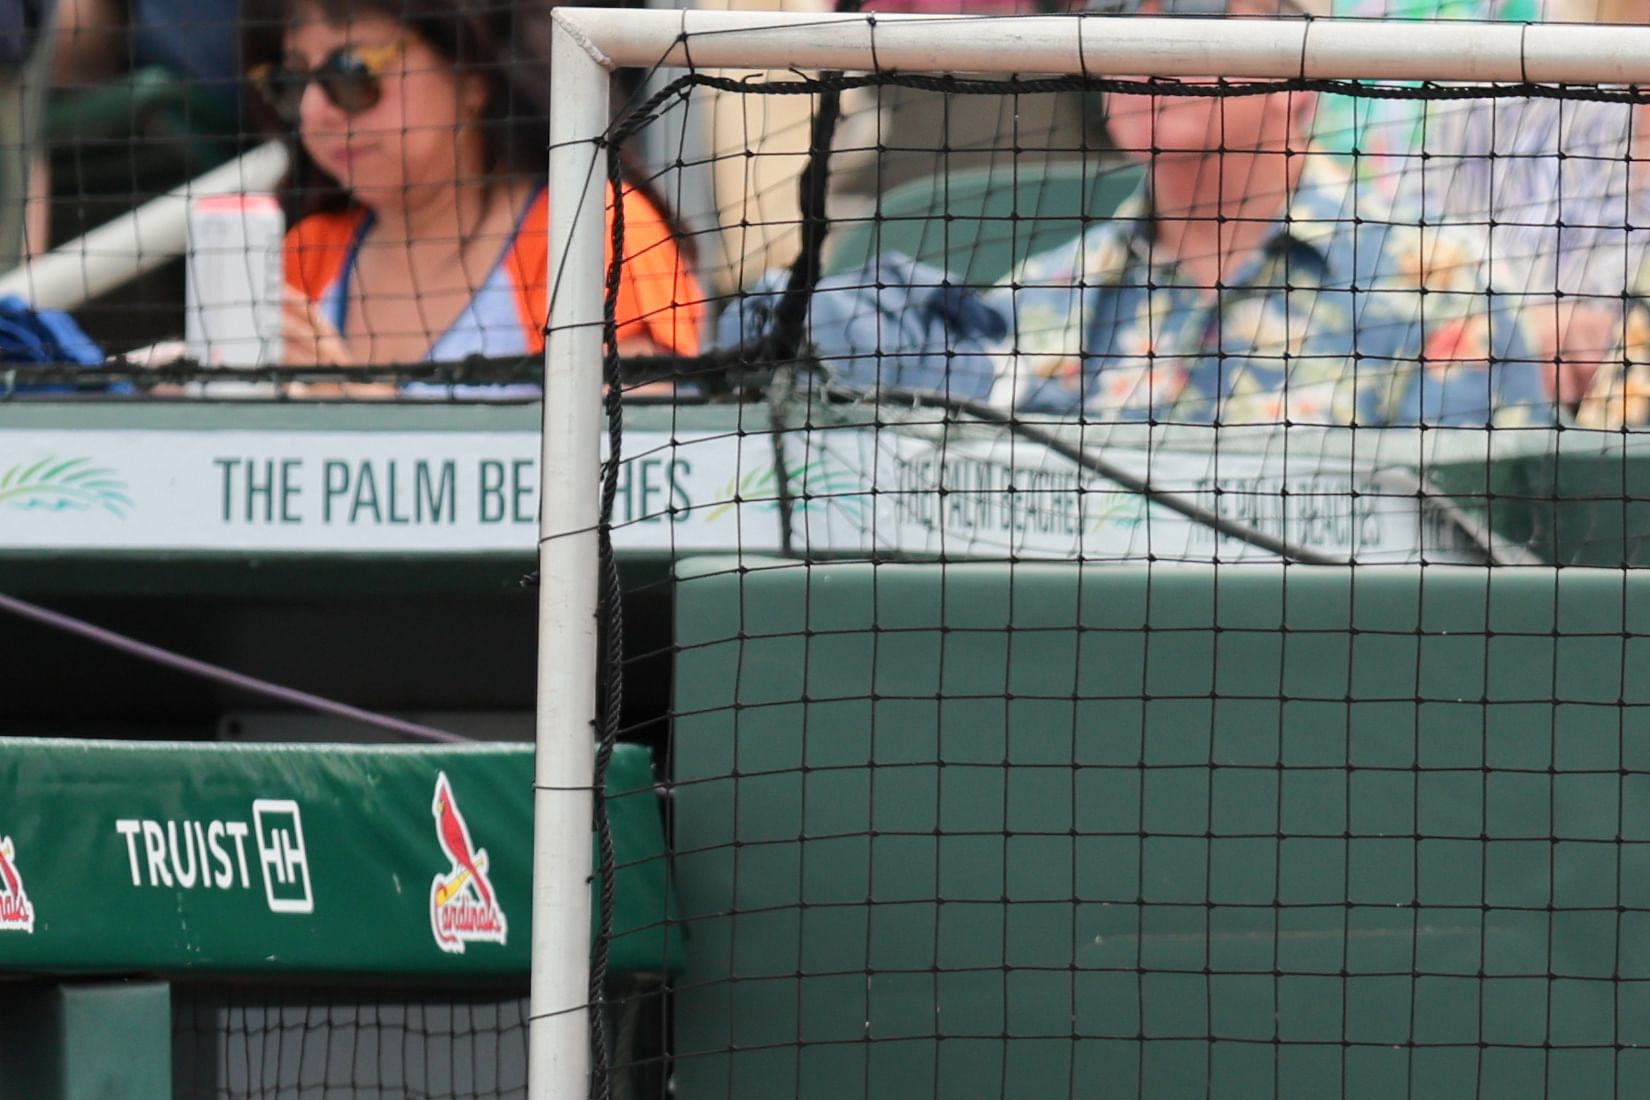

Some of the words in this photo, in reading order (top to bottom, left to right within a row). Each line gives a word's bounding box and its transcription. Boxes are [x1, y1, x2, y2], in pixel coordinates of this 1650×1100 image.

[212, 457, 304, 524] THE
[323, 458, 457, 525] PALM
[478, 457, 692, 525] BEHES
[115, 819, 250, 889] TRUIST
